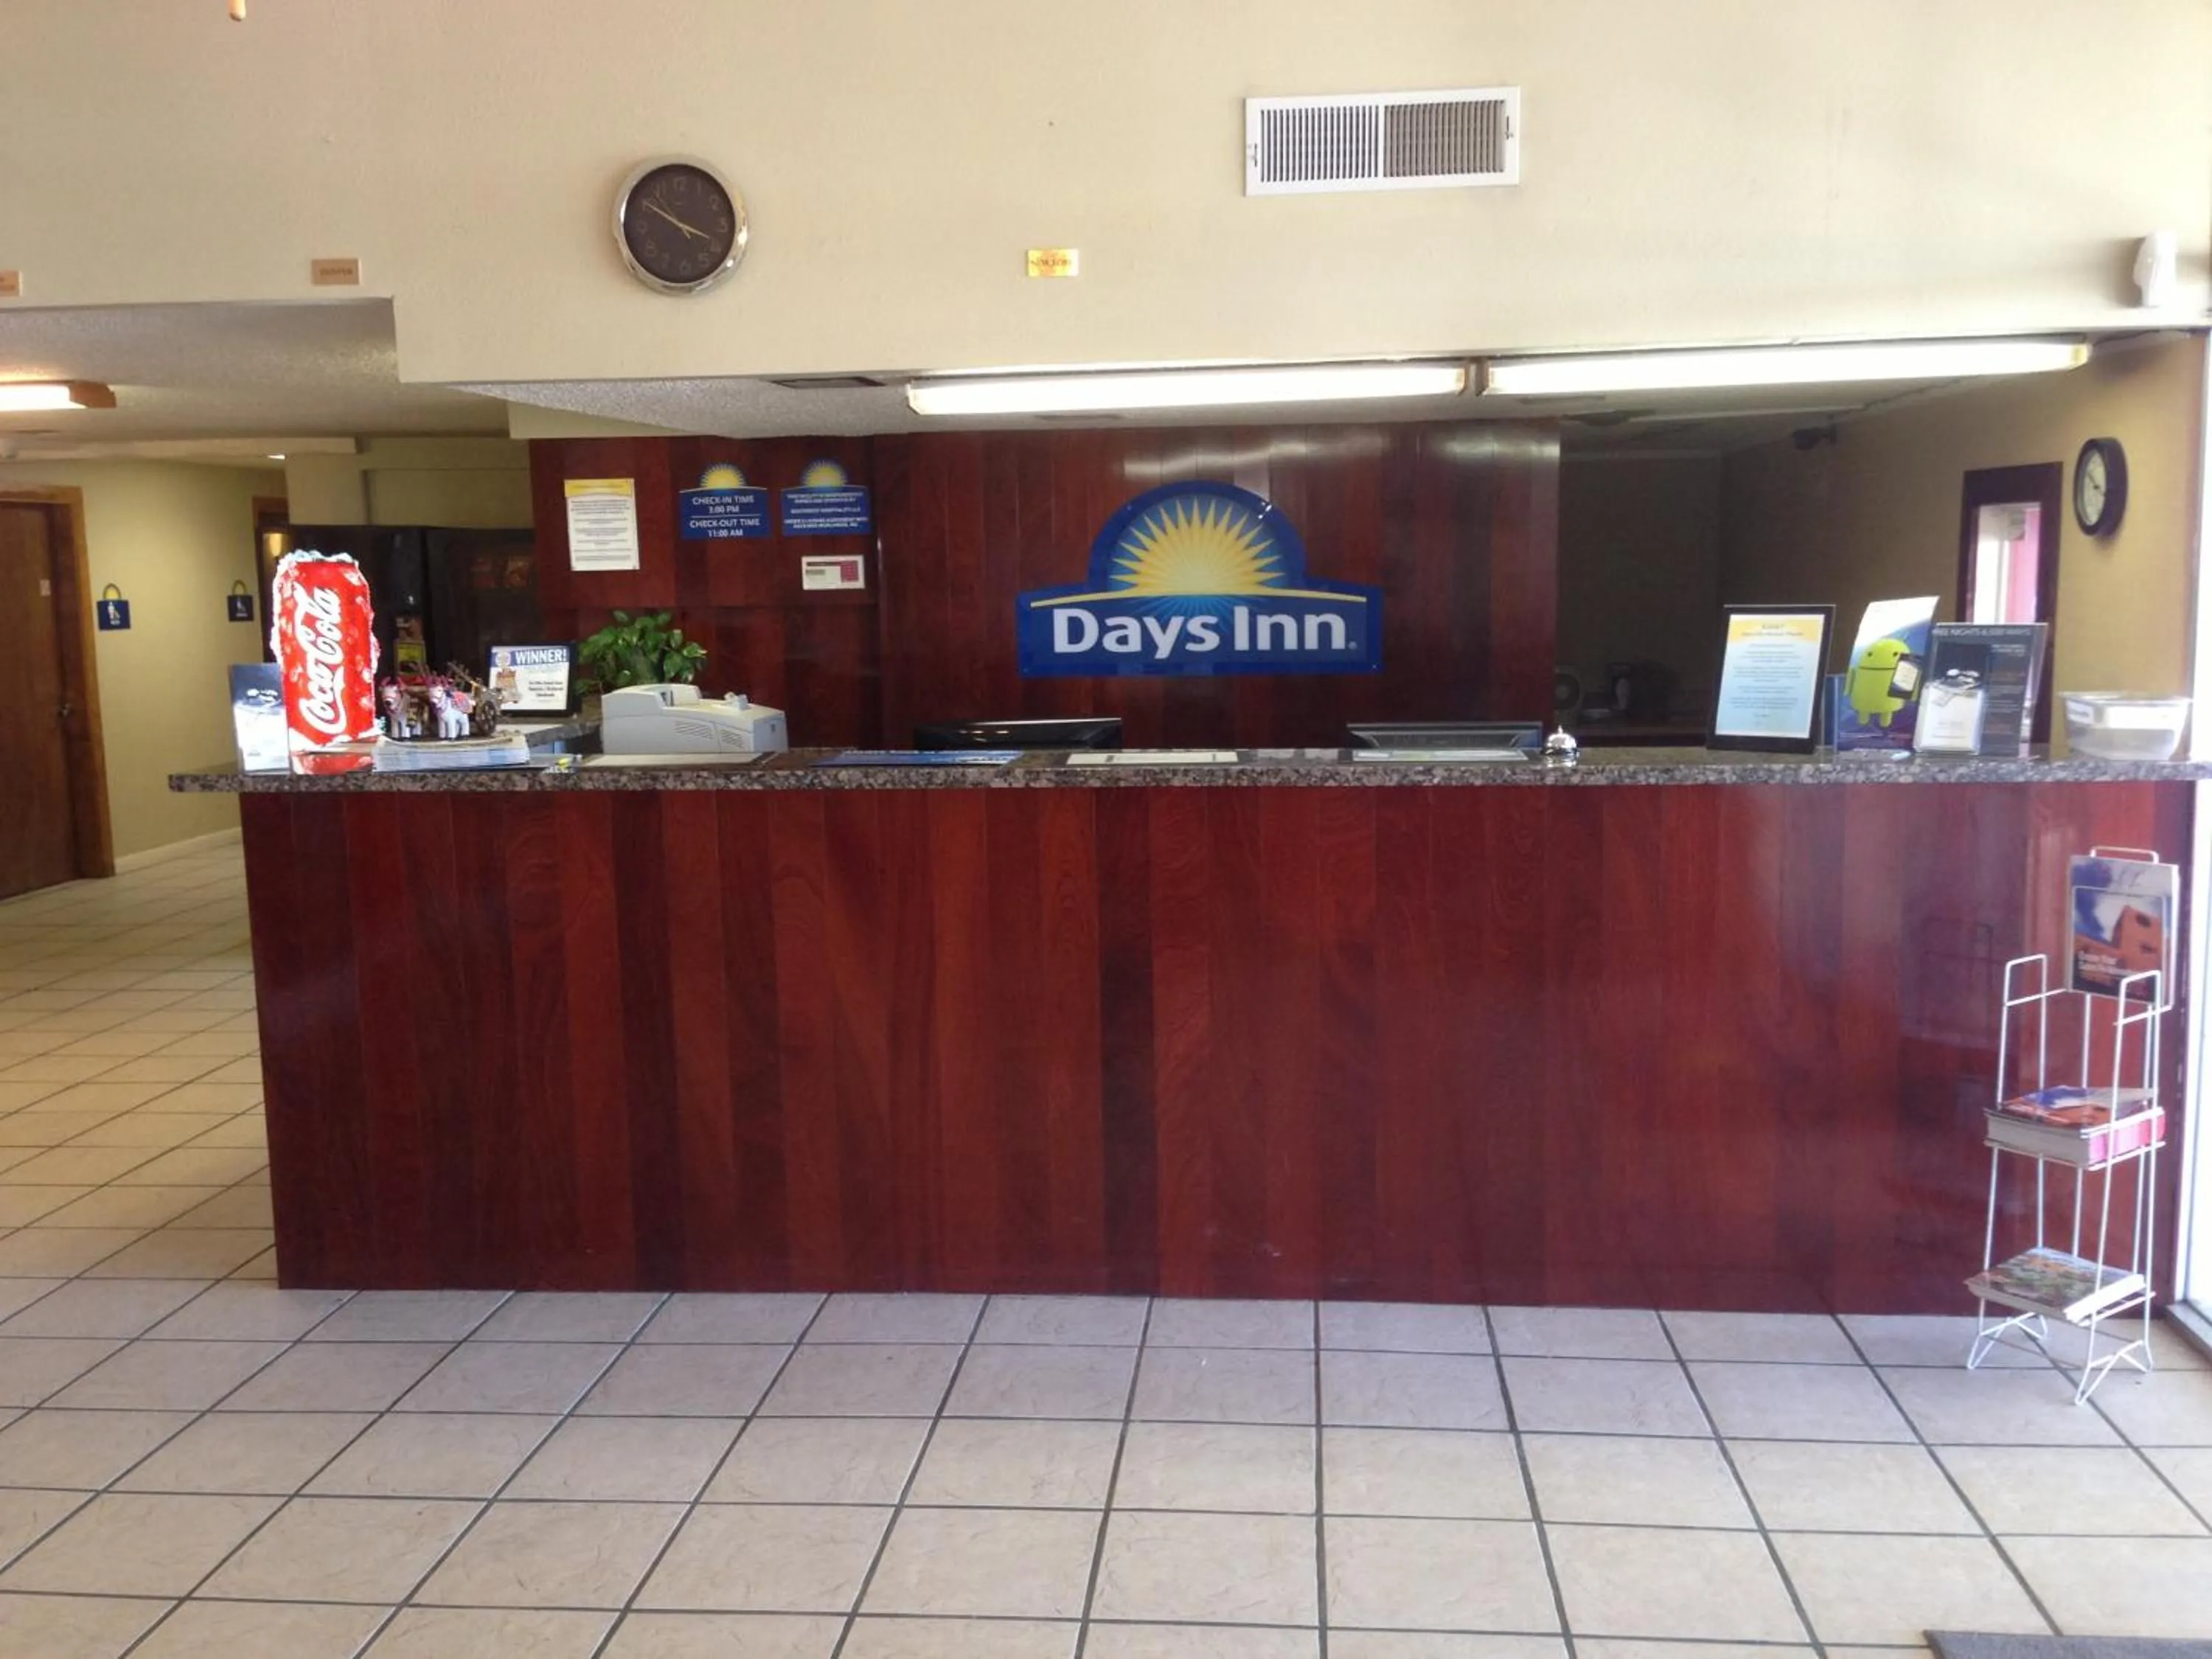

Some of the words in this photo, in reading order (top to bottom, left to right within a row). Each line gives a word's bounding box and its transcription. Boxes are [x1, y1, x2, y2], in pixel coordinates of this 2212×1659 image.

[734, 495, 754, 504] TIME
[689, 518, 737, 529] CHECK-OUT
[740, 518, 760, 526] TIME
[1053, 608, 1220, 659] Days
[1234, 605, 1346, 650] Inn
[515, 649, 567, 666] WINNER!
